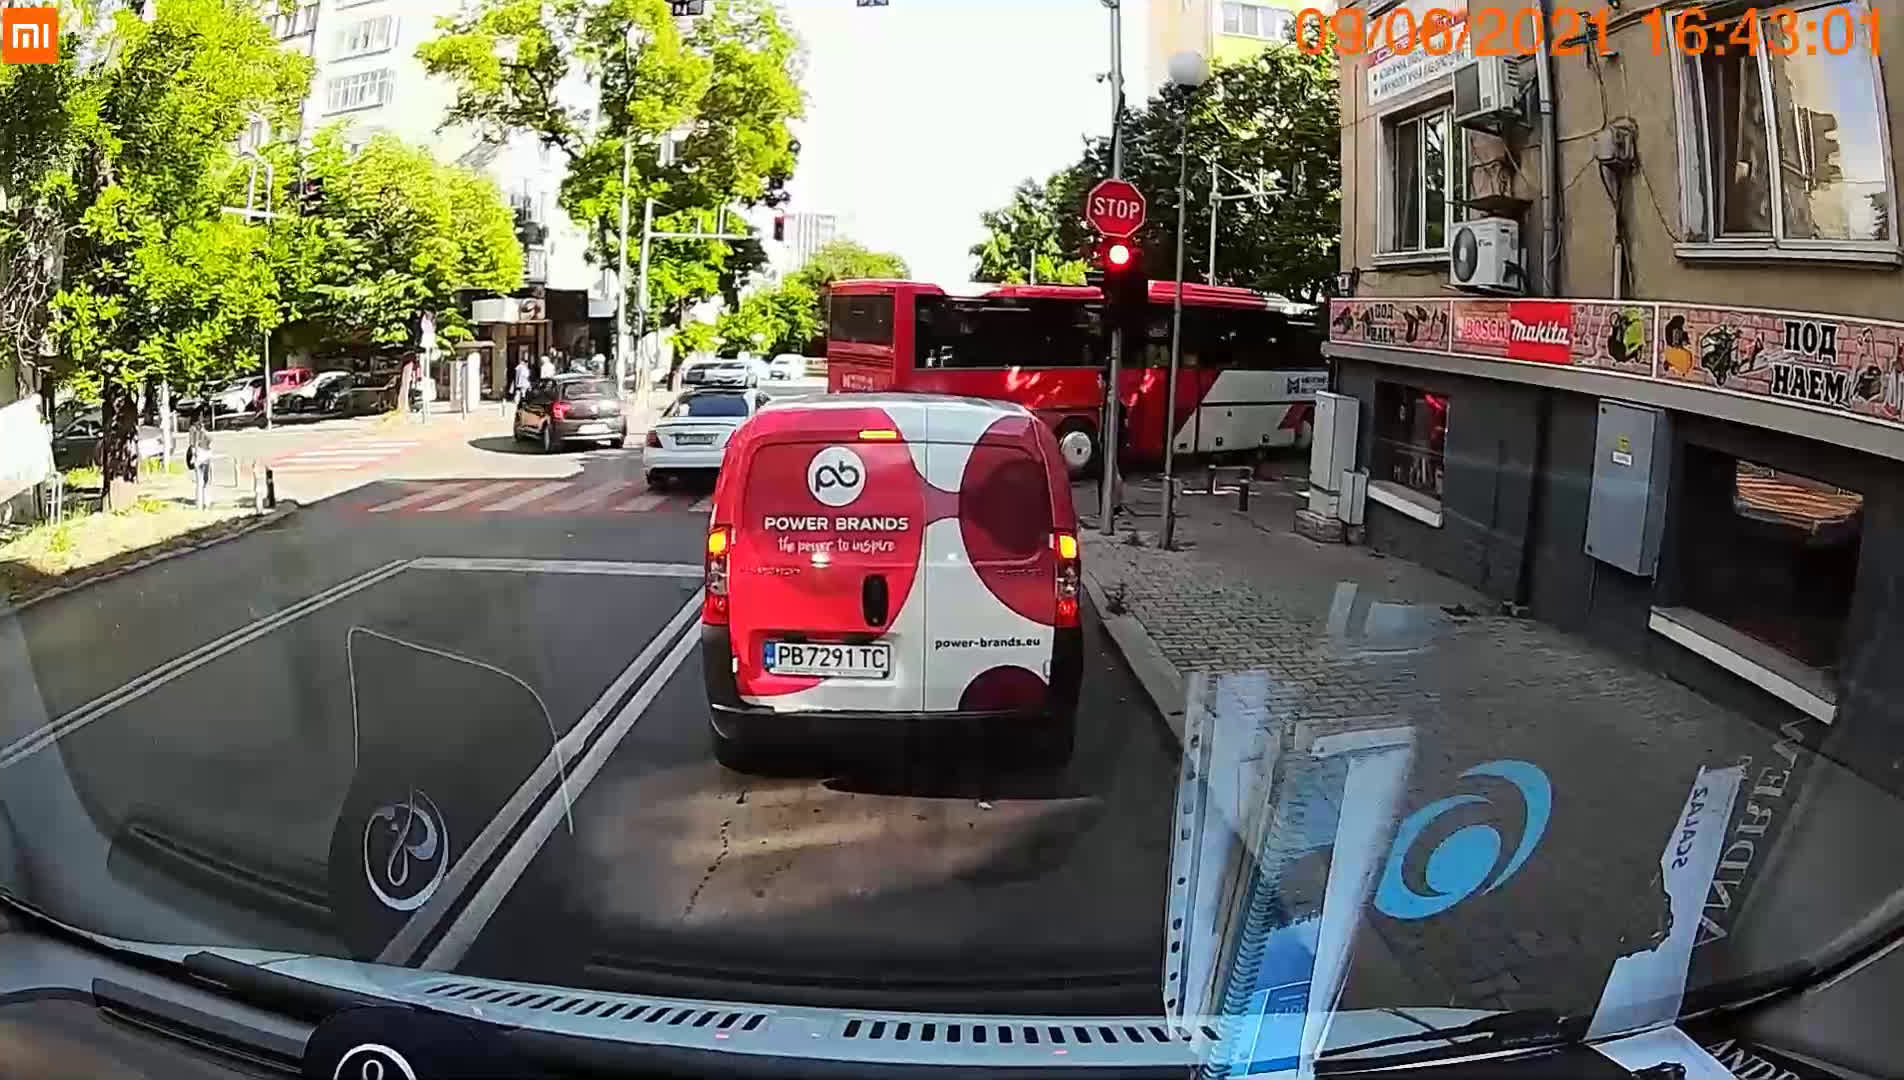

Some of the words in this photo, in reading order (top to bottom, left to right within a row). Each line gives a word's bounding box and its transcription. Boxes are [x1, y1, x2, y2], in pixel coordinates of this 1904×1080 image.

[1094, 197, 1140, 219] STOP
[1464, 317, 1509, 339] BOSCH
[1784, 321, 1837, 363] ПОД
[1772, 364, 1849, 404] НАЕМ
[764, 517, 829, 531] POWER
[835, 517, 909, 531] BRANDS
[777, 535, 795, 552] the
[837, 537, 849, 551] to
[852, 540, 896, 555] inspire
[935, 637, 1041, 651] power-brands.eu
